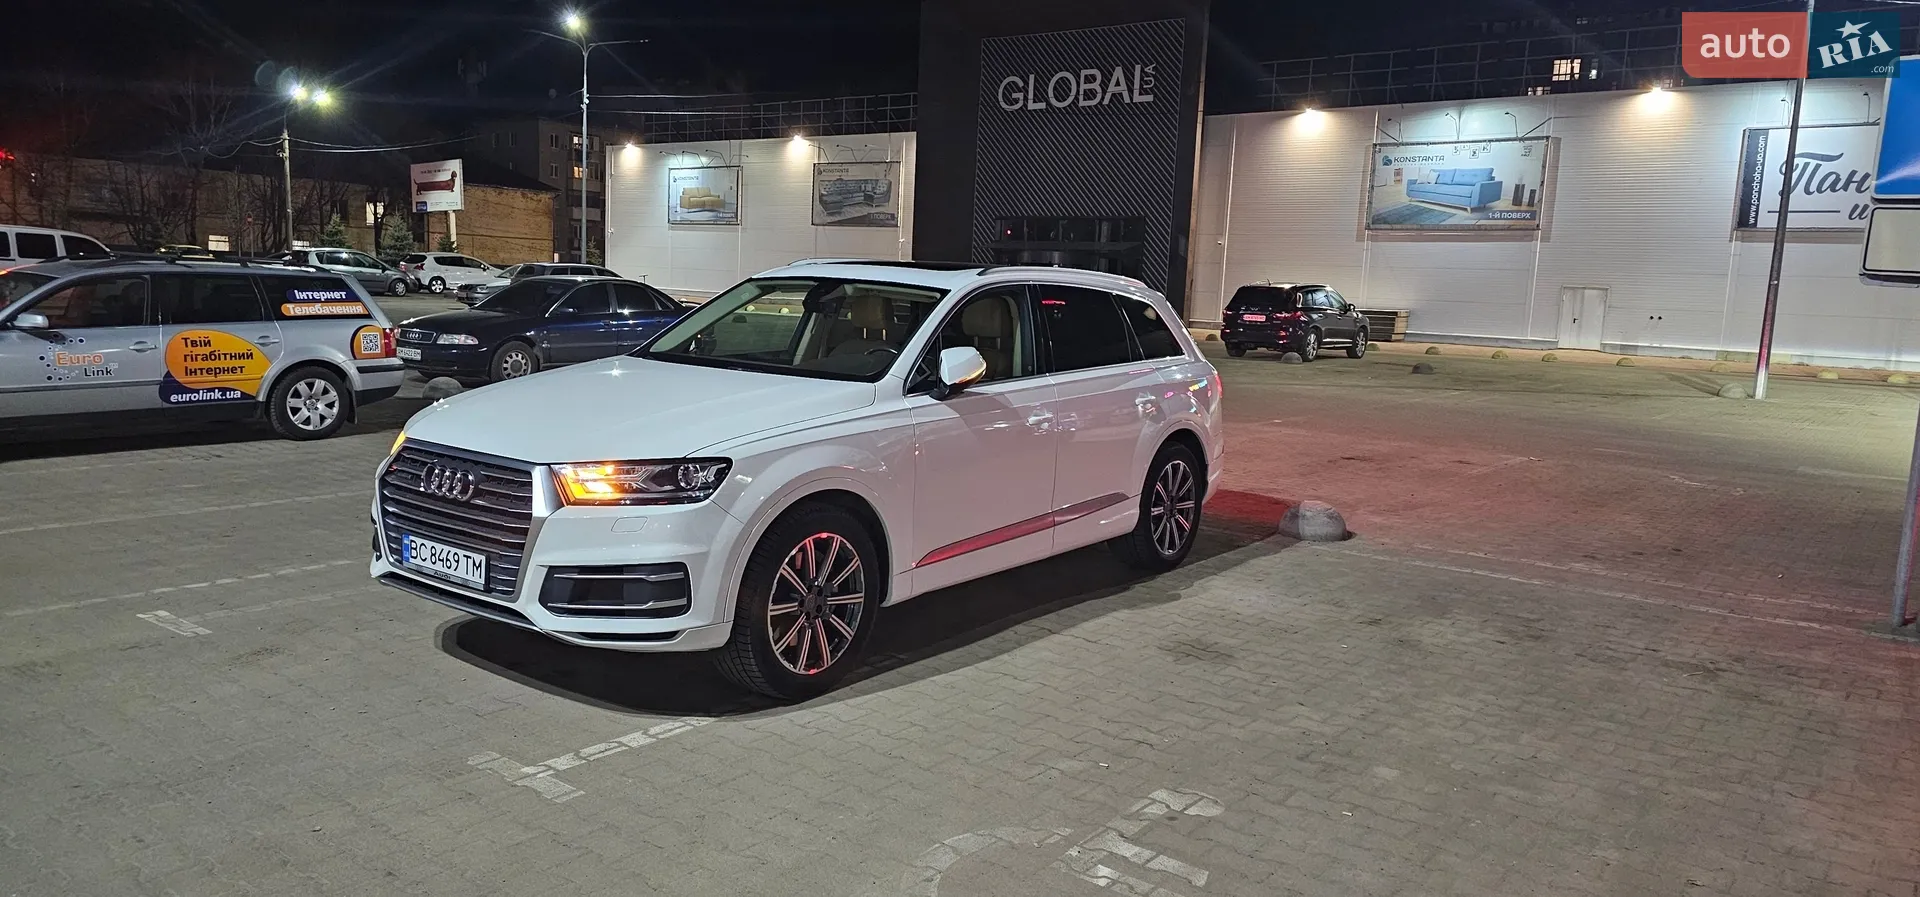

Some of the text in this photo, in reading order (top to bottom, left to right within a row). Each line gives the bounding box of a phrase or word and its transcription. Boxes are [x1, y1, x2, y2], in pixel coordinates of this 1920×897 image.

[1143, 63, 1157, 89] UA
[998, 64, 1154, 111] GLOBAL
[1393, 155, 1445, 163] KONSTANTA
[1488, 210, 1501, 219] 1-Й
[294, 289, 347, 301] Інтернет
[287, 304, 363, 315] Телебачення
[181, 336, 212, 348] Твій
[56, 352, 104, 366] Euro
[183, 349, 254, 363] гігабітний
[84, 366, 113, 377] Link
[184, 365, 245, 378] Інтернет
[170, 389, 241, 402] eurolink.ua
[410, 540, 483, 579] BC 8469 TM
